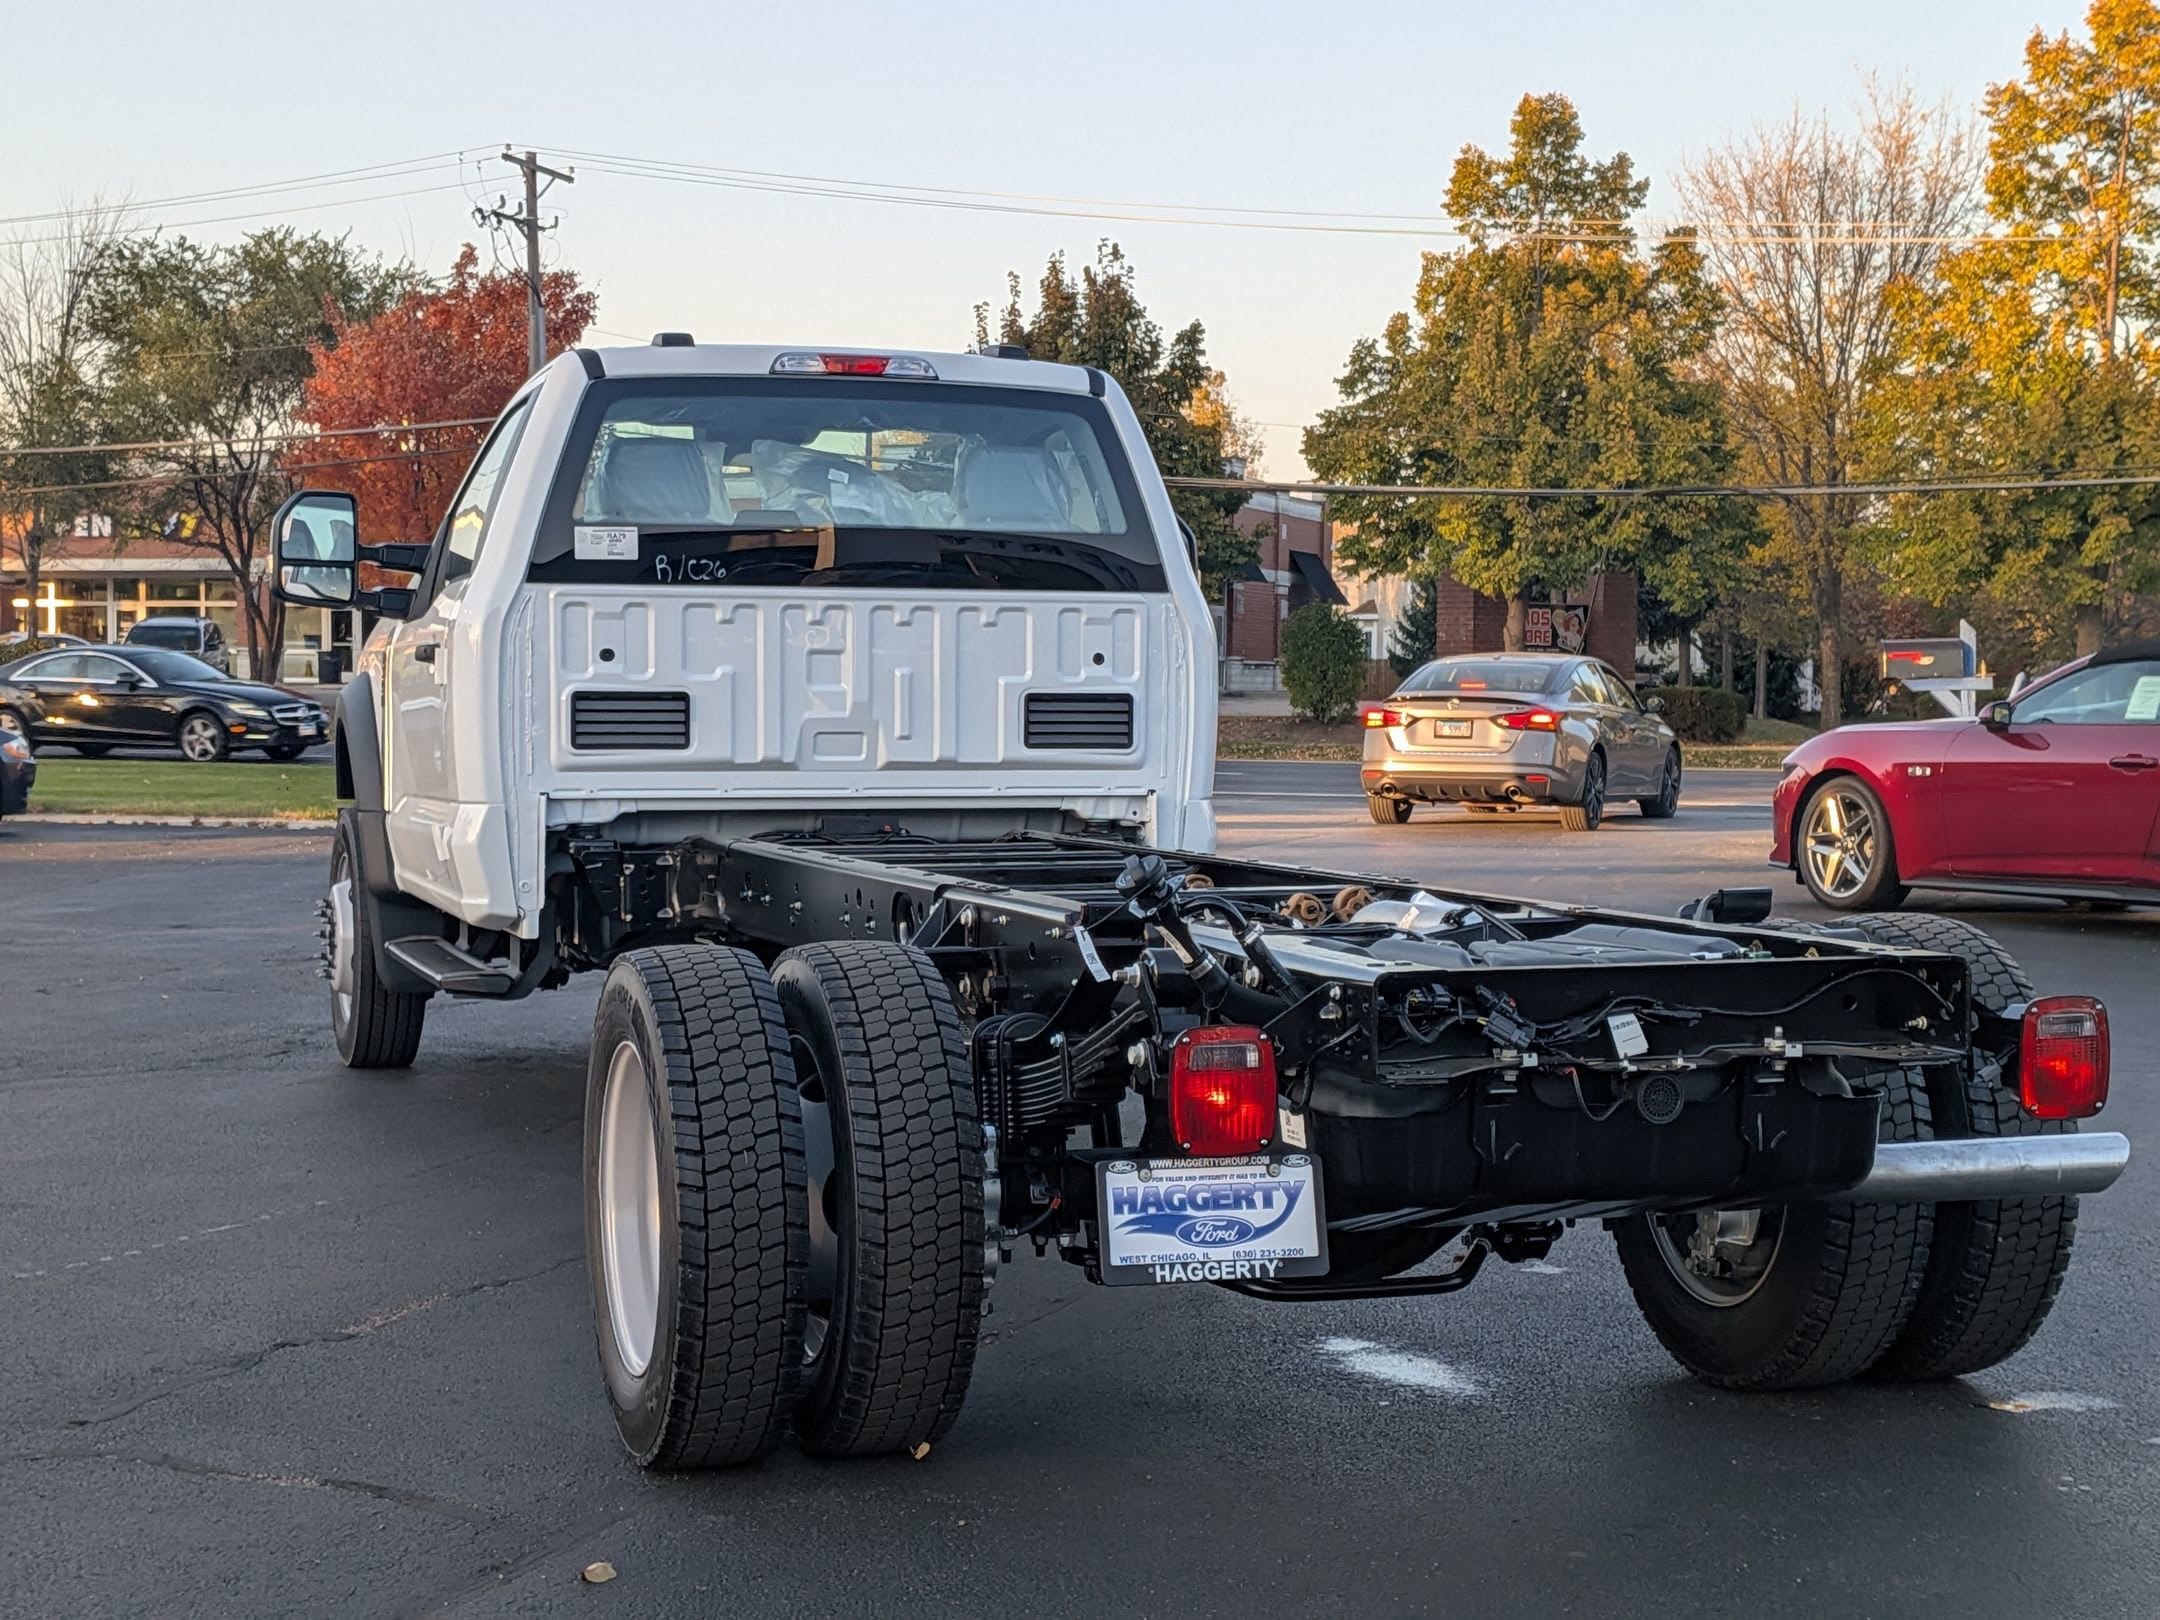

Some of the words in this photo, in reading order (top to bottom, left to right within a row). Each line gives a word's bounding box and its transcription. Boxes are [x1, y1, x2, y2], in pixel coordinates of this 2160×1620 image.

[1149, 1155, 1270, 1169] WWW.HAGGERTYGROUP.COM
[1112, 1180, 1306, 1216] HAGGERTY
[1191, 1220, 1240, 1243] Ford
[1119, 1255, 1148, 1264] WEST
[1150, 1252, 1200, 1262] CHICAGO,
[1202, 1252, 1212, 1260] IL
[1260, 1247, 1304, 1258] 231-3200
[1154, 1259, 1279, 1283] HAGGERTY
